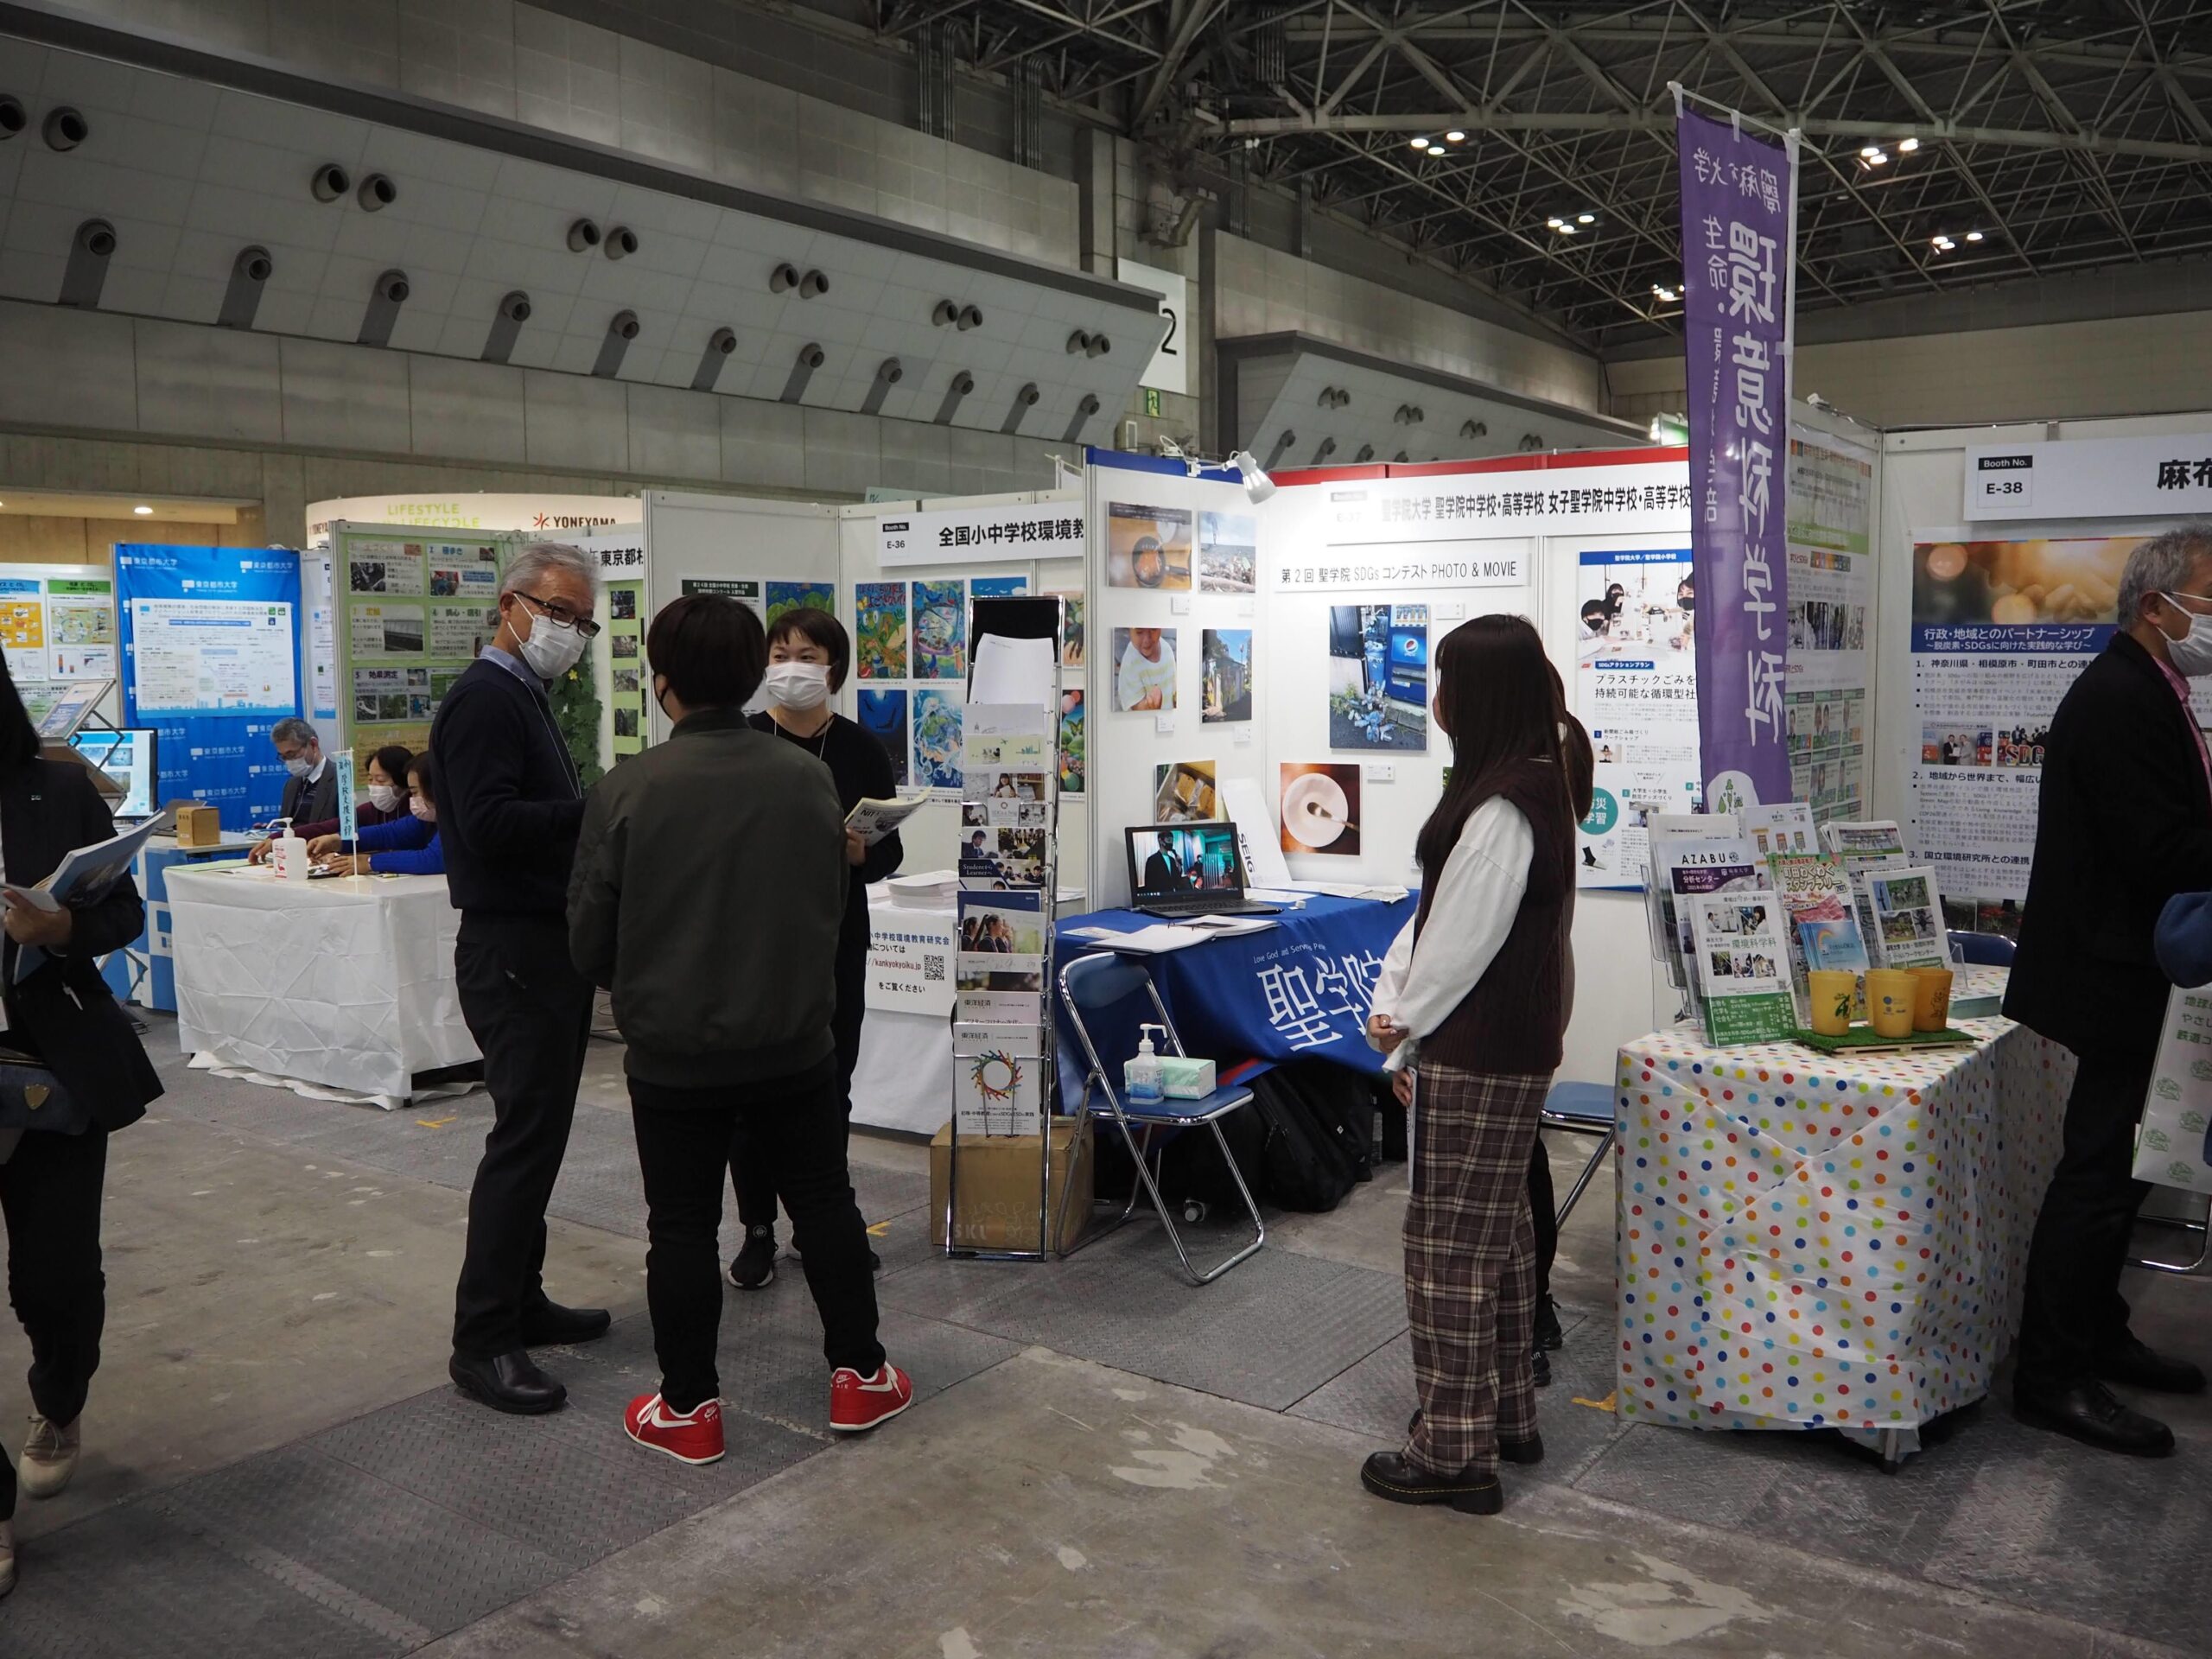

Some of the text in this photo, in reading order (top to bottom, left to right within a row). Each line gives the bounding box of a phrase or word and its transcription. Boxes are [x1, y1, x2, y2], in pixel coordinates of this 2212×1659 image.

[1160, 308, 1177, 355] 2
[1983, 458, 2027, 468] Booth No.
[1986, 481, 2023, 495] E-38
[1435, 490, 1545, 519] 聖学院中学校・高等学校
[1548, 483, 1691, 515] 女子聖学院中学校・高等学校
[388, 503, 460, 516] LIFESTYLE
[938, 518, 1084, 548] 全国小中学校環境教
[887, 540, 906, 550] E-36
[1319, 567, 1351, 583] 聖学院
[1354, 566, 1380, 581] SDGs
[1382, 563, 1427, 580] コンテスト
[1432, 563, 1467, 578] PHOTO
[1471, 562, 1479, 576] &
[1484, 561, 1517, 576] MOVIE
[1923, 627, 2095, 640] 行政・地域とのパートナーシップ
[1931, 658, 2093, 670] 神奈川県・相模原市・町田市との連
[1596, 674, 1696, 685] プラスチックごみを
[1595, 688, 1696, 700] 持続可能な循環型社
[1681, 853, 1726, 865] AZABU
[1924, 850, 2030, 865] 国立環境研究所との連携
[1783, 865, 1835, 879] 町田わくわく
[870, 931, 950, 945] 中学校環境教育研究会
[1732, 937, 1777, 949] 環境科学科
[1253, 954, 1265, 964] Love
[1266, 950, 1279, 960] God
[879, 982, 925, 993] をご覧ください
